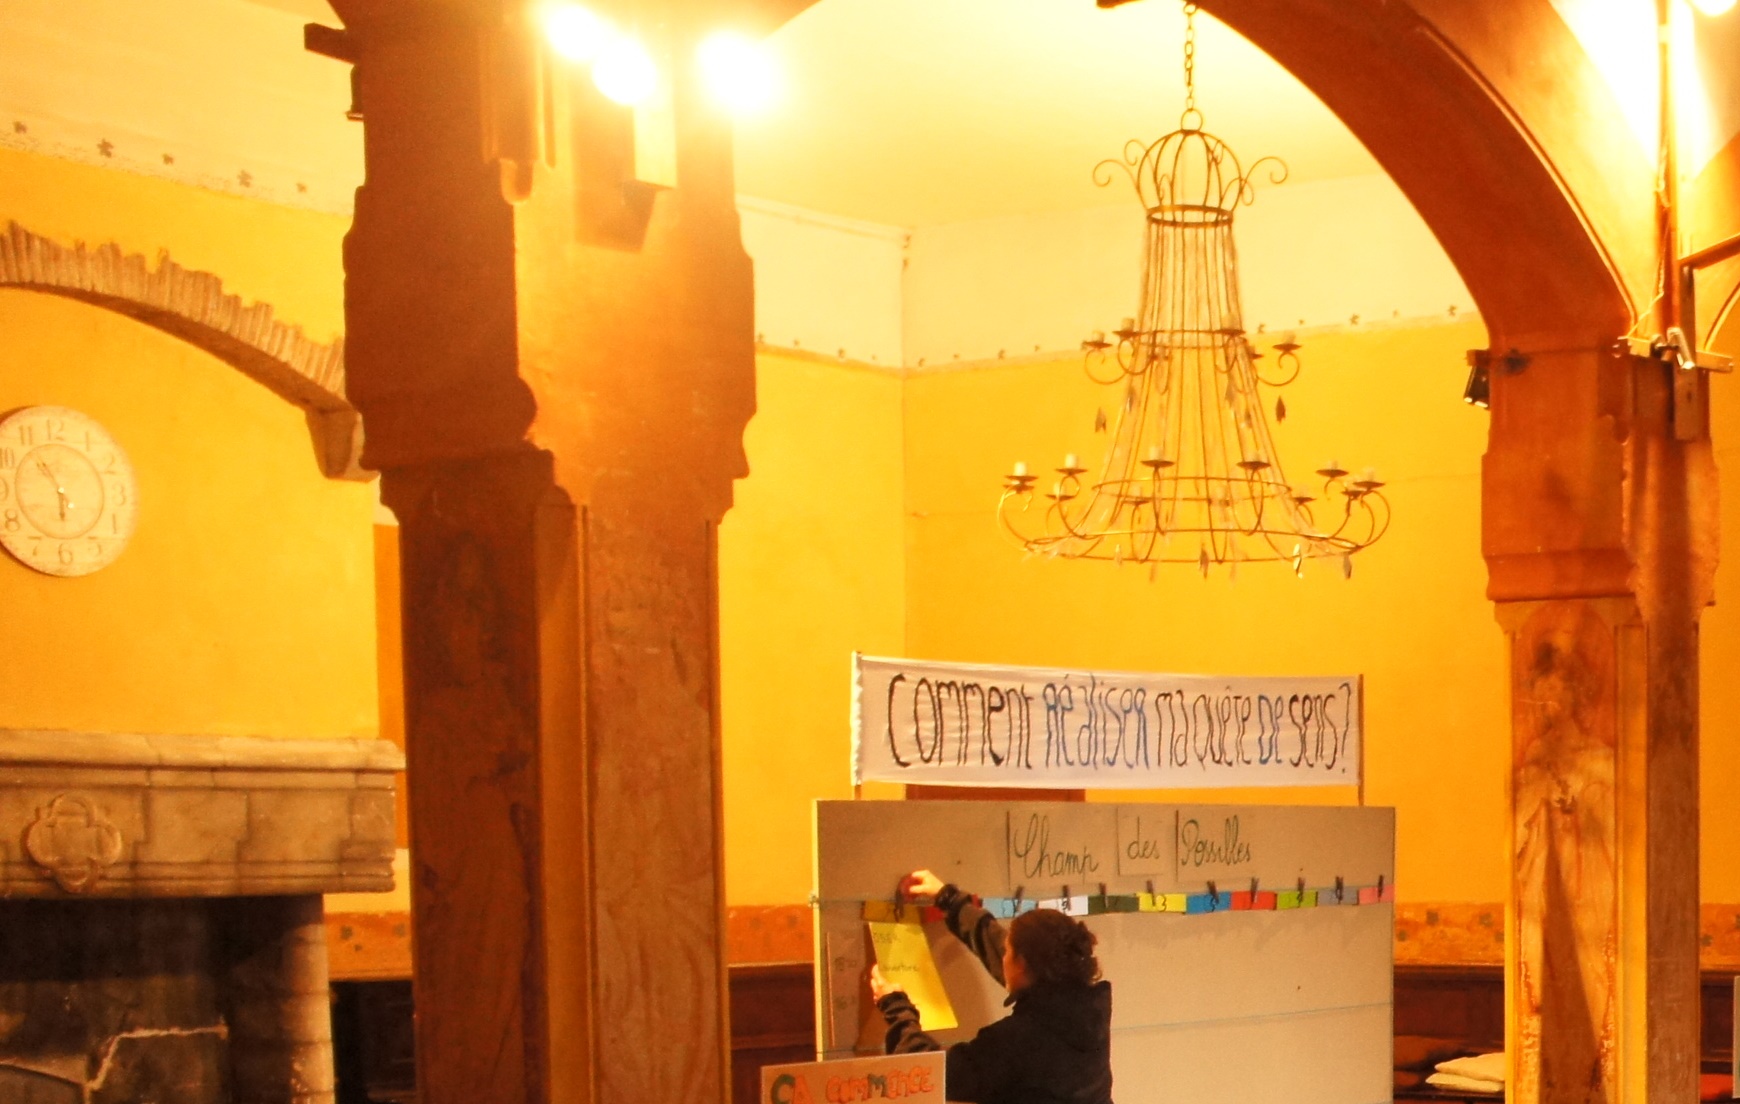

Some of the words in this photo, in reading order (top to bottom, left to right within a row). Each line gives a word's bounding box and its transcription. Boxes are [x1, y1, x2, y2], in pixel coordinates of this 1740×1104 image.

[19, 425, 33, 446] 11
[46, 419, 65, 441] 12
[4, 508, 21, 533] 8
[57, 542, 74, 566] 6
[1013, 812, 1100, 884] Champ
[1126, 815, 1160, 861] des
